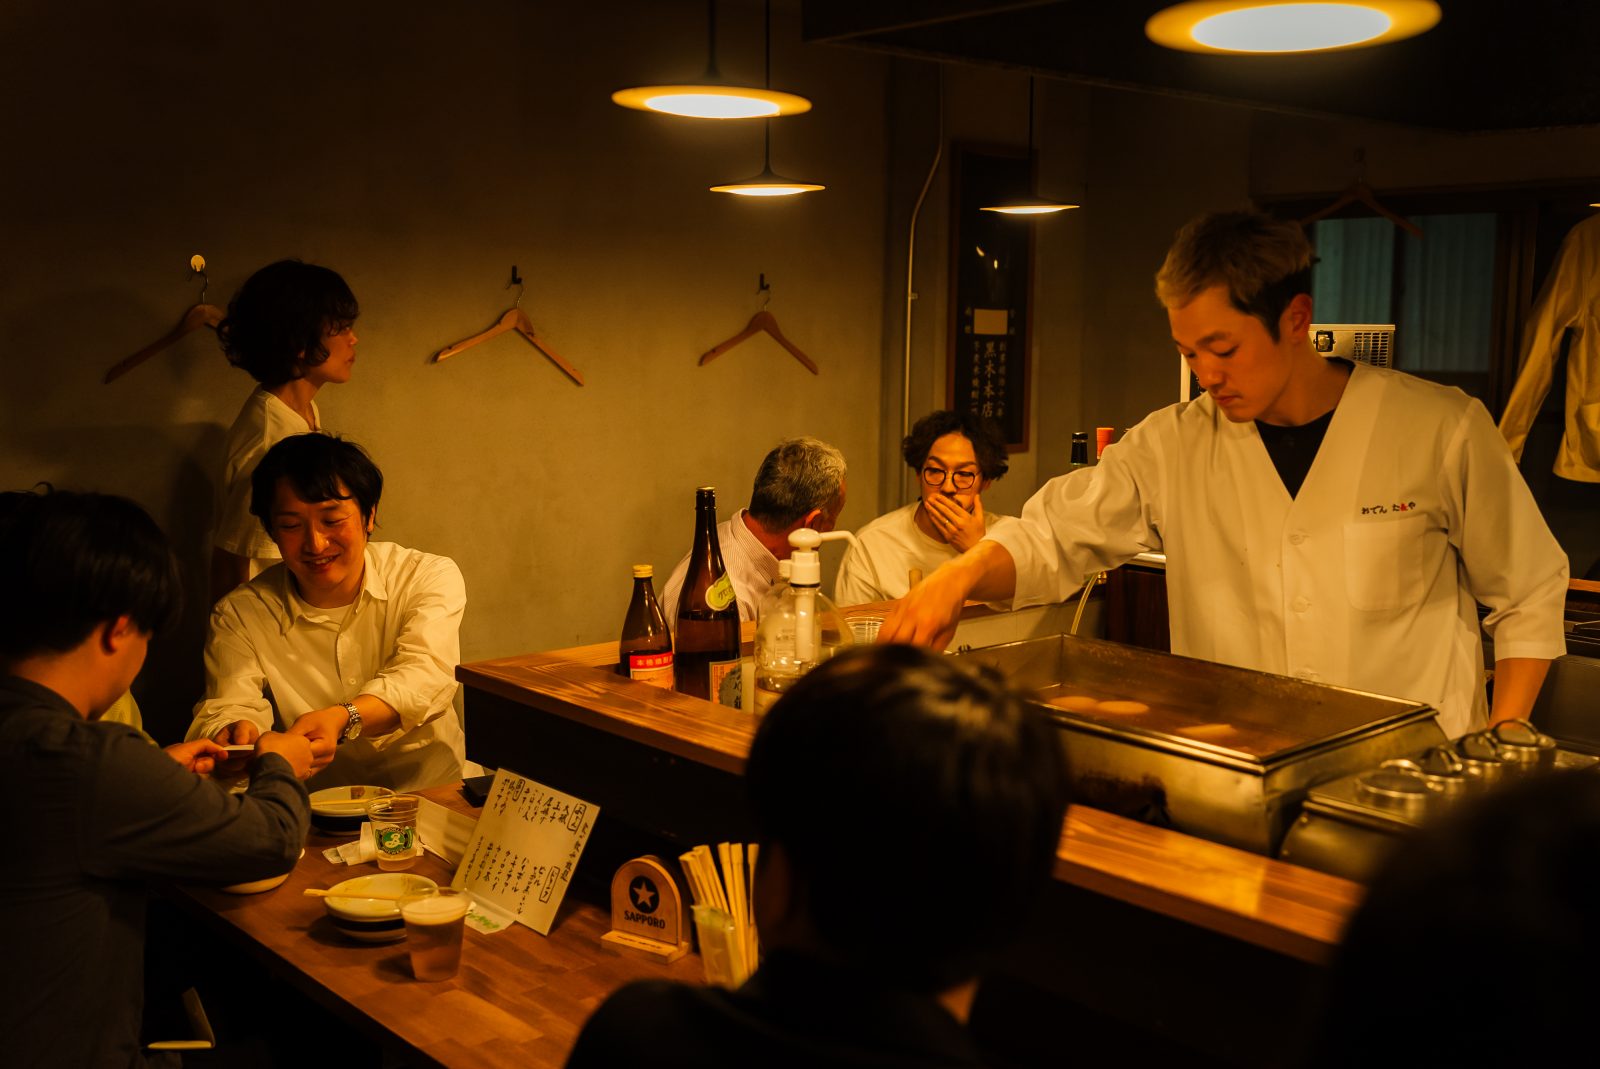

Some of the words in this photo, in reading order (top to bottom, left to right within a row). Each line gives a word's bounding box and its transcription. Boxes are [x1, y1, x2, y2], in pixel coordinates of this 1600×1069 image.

[981, 341, 997, 418] 黒木本店
[1361, 505, 1387, 515] おでん
[624, 910, 665, 929] SAPPORO
